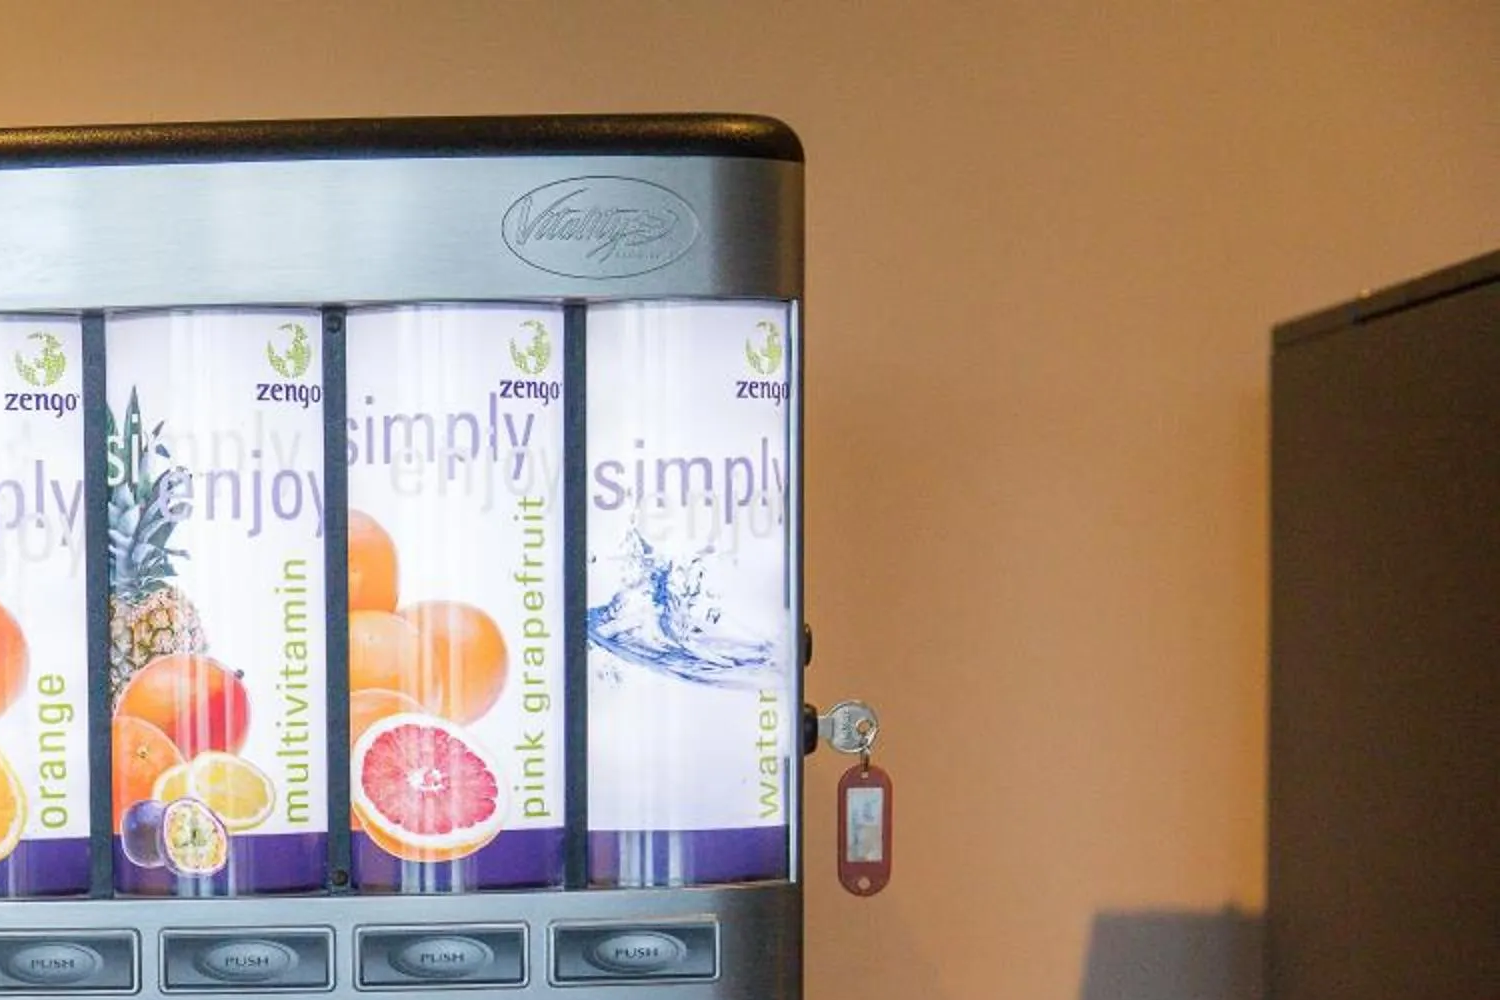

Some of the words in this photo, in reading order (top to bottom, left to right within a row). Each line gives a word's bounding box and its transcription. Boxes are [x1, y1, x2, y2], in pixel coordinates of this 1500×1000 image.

[5, 392, 77, 418] zengo
[256, 383, 321, 408] zengo
[500, 379, 560, 406] zengo
[347, 392, 535, 480] simply
[158, 449, 323, 538] enjoy
[514, 496, 550, 713] grapefruit
[275, 559, 309, 824] multivitamin
[38, 673, 74, 829] orange
[514, 730, 550, 818] pink
[756, 690, 779, 818] water
[30, 958, 76, 970] PUSH
[225, 955, 270, 967] PUSH
[420, 952, 466, 965] PUSH
[615, 946, 659, 959] PUSH
